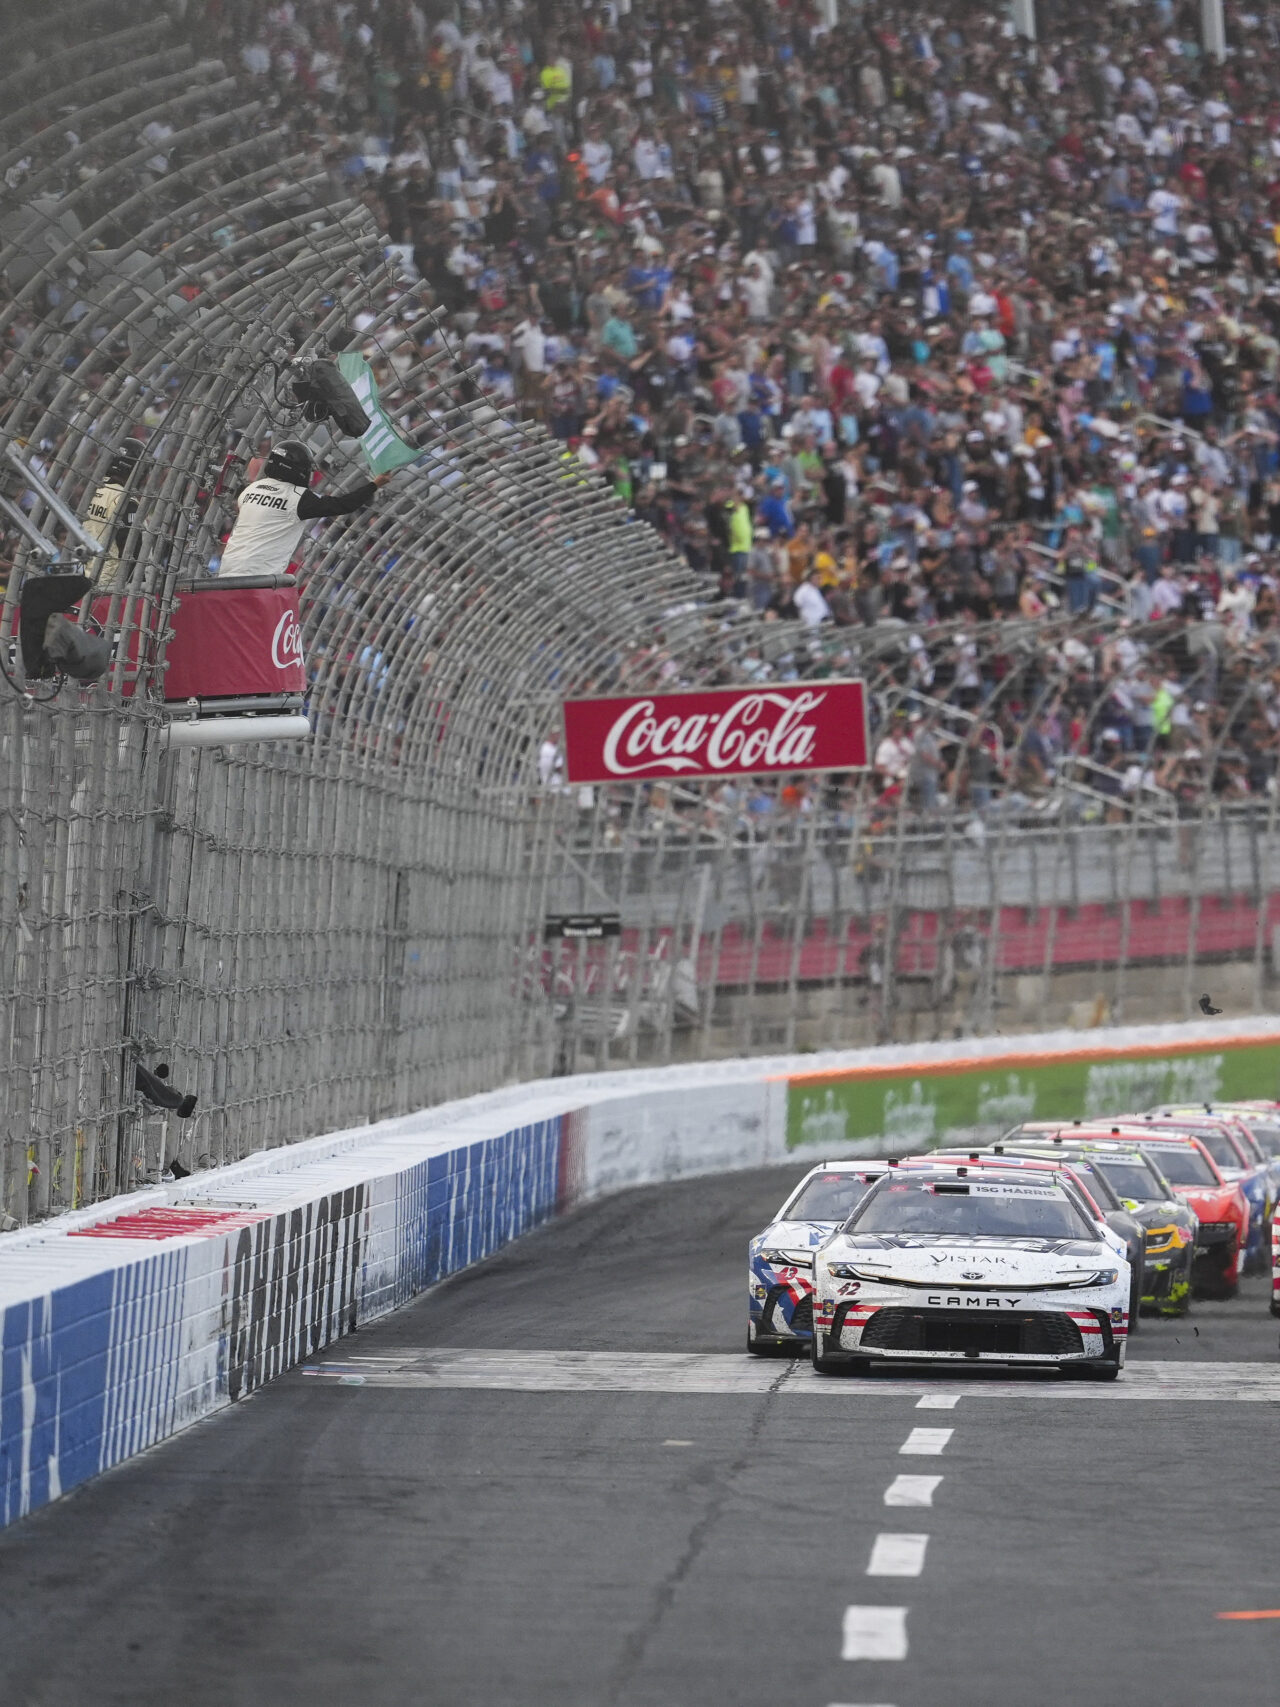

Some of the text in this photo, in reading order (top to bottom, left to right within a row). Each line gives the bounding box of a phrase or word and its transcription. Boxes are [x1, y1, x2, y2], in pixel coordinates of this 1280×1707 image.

[243, 493, 288, 511] OFFICIAL
[603, 691, 828, 774] Coca-Cola
[1002, 1187, 1057, 1197] HARRIS
[837, 1281, 861, 1296] 42
[927, 1295, 1022, 1308] CAMRY
